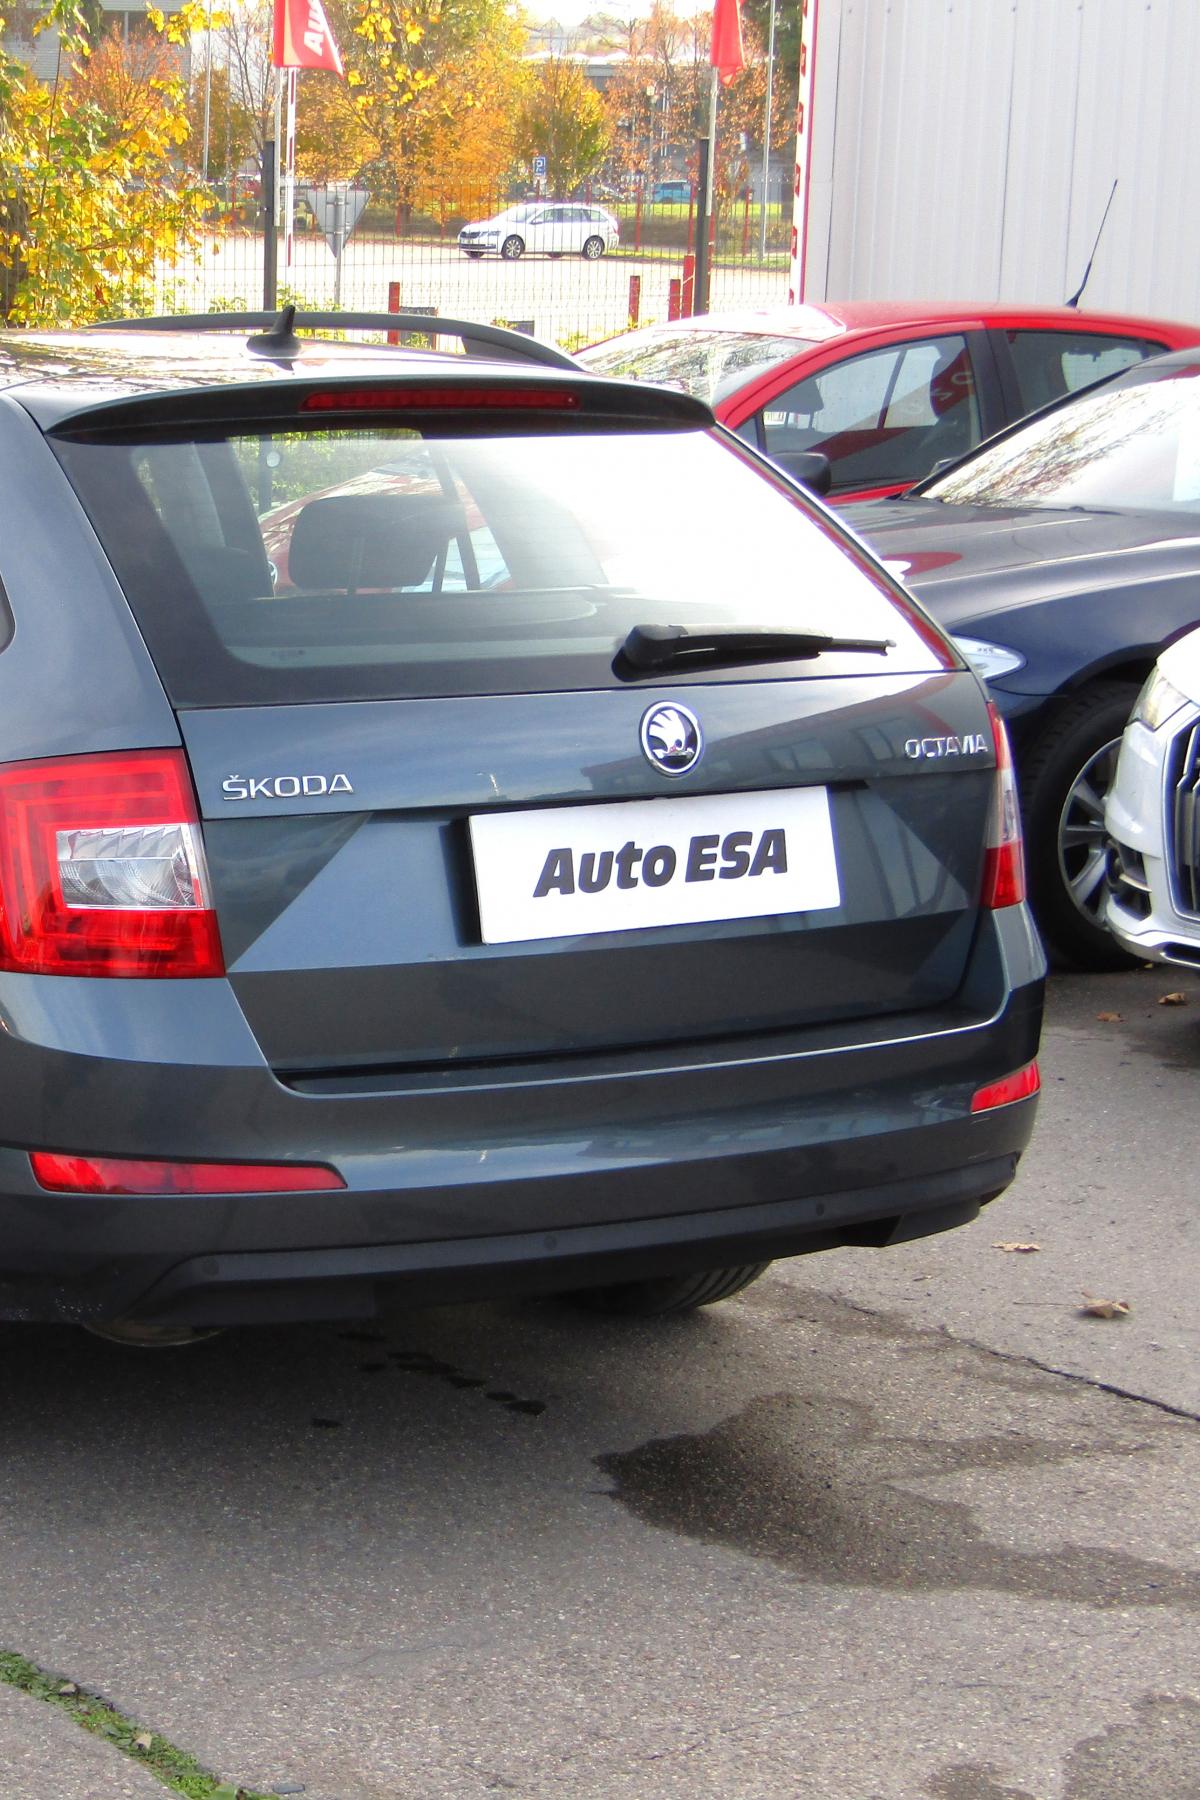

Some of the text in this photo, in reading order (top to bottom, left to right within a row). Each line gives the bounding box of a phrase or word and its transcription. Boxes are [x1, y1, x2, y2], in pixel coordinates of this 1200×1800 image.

[904, 734, 989, 759] OCTAVIA
[222, 774, 354, 801] ŠKODA
[532, 828, 788, 898] Auto ESA
